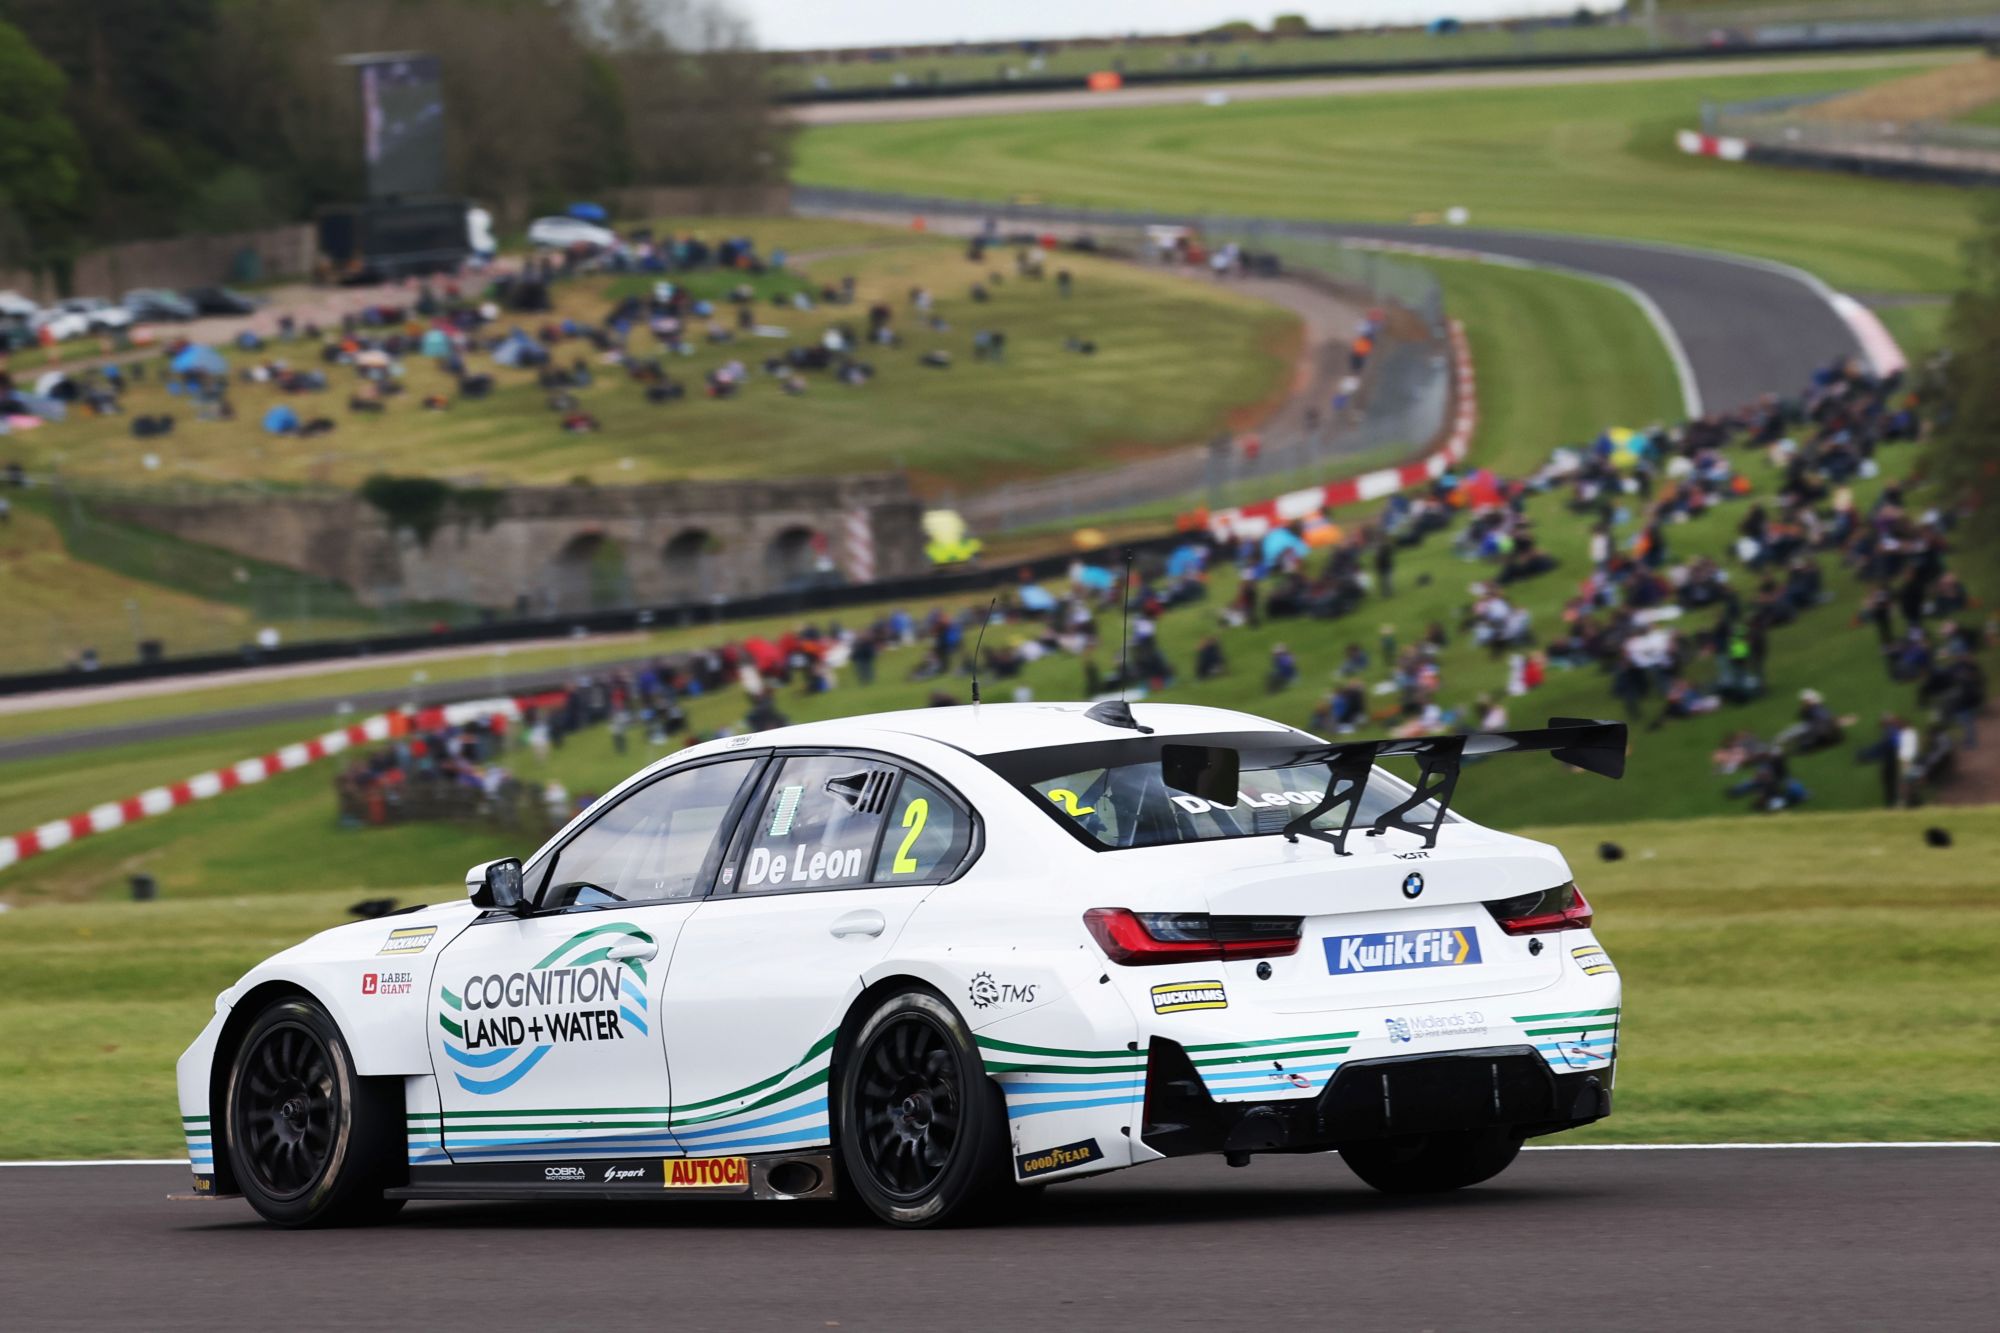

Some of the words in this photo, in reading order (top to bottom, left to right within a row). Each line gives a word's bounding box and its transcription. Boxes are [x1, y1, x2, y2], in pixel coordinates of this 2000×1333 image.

[1047, 788, 1095, 817] 2
[1237, 790, 1326, 808] Leon
[892, 798, 929, 874] 2
[747, 847, 787, 885] De
[791, 843, 862, 882] Leon
[381, 972, 413, 983] LABEL
[380, 983, 412, 995] GIANT
[463, 966, 623, 1011] COGNITION
[1001, 984, 1037, 1003] TMS
[1153, 989, 1225, 1007] DUCKHAMS
[1466, 1011, 1484, 1024] 3D
[544, 1167, 586, 1176] COBRA
[615, 1168, 645, 1180] spark
[671, 1158, 748, 1185] AUTOCA
